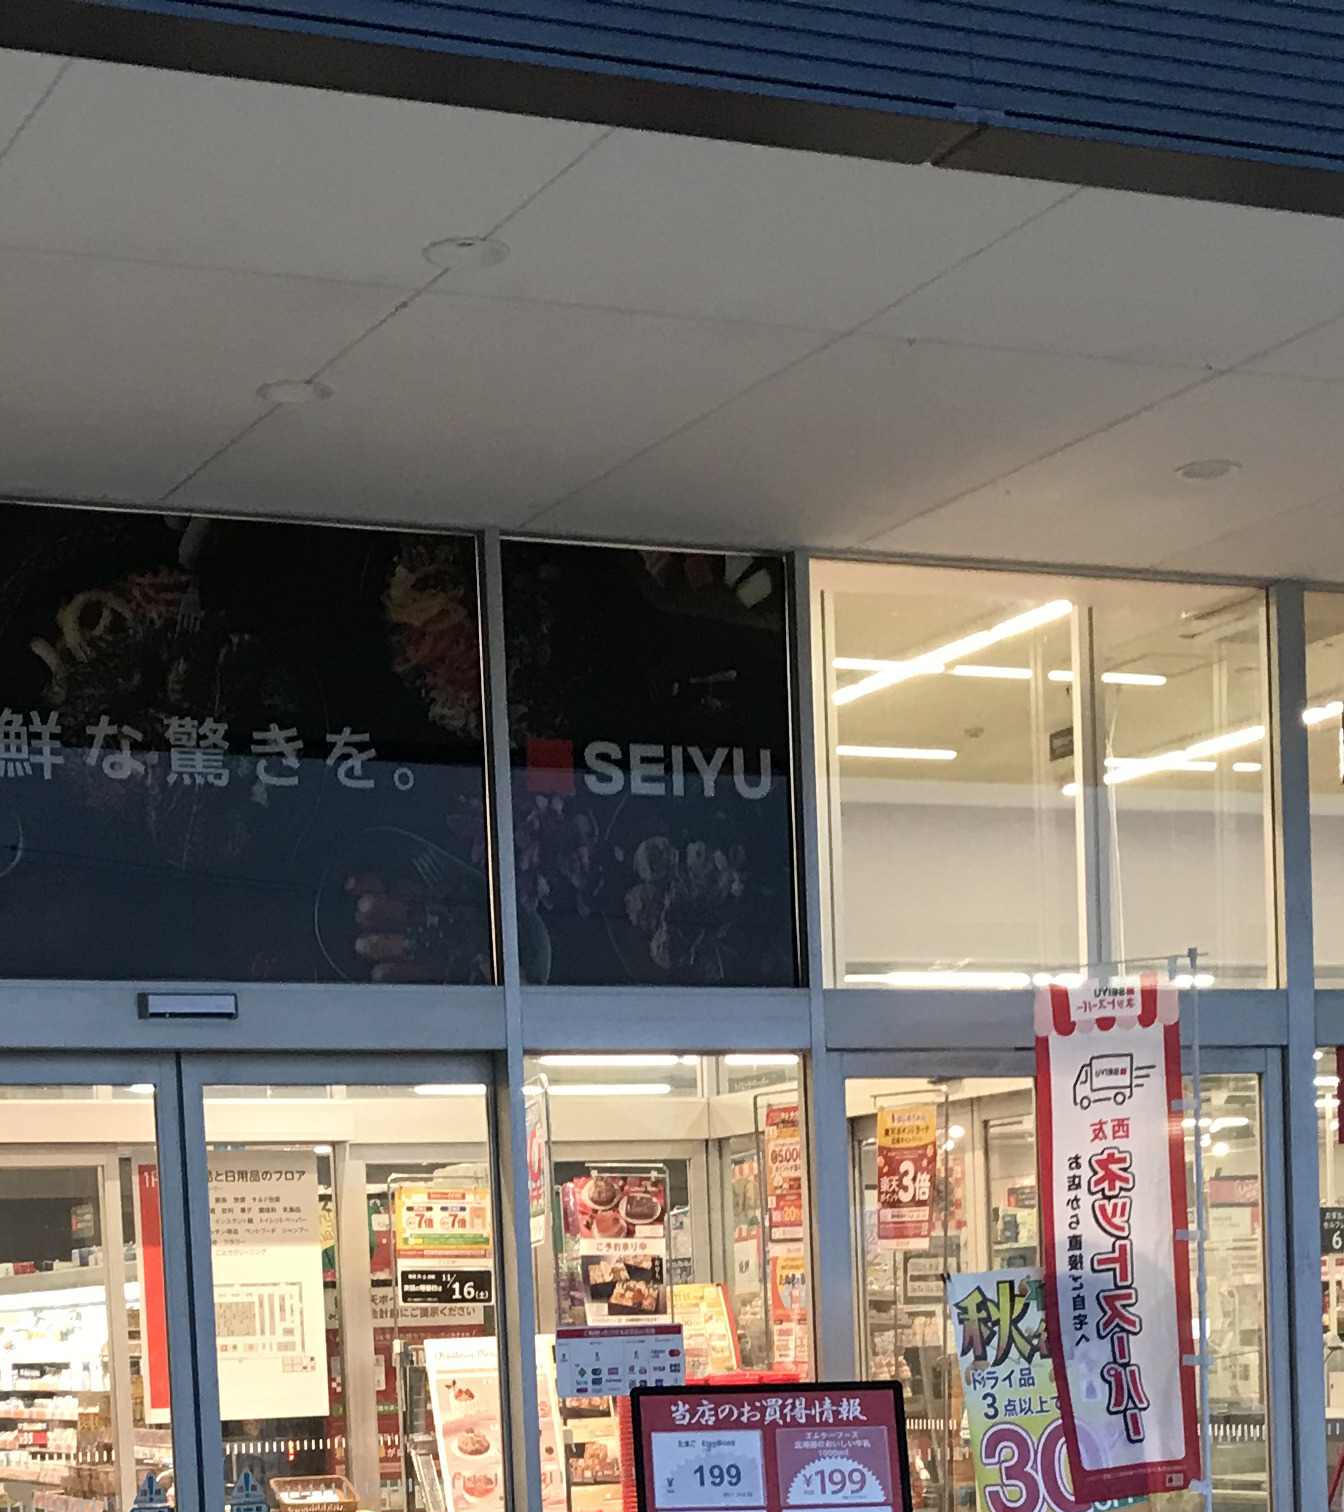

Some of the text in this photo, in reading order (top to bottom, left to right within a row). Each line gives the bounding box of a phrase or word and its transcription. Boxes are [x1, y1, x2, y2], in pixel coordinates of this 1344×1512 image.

[583, 740, 772, 799] SEIYU
[1332, 1230, 1342, 1249] 6
[971, 1367, 1035, 1391] ドライ品
[670, 1397, 867, 1426] 当店のお買得情報
[693, 1463, 742, 1488] 199
